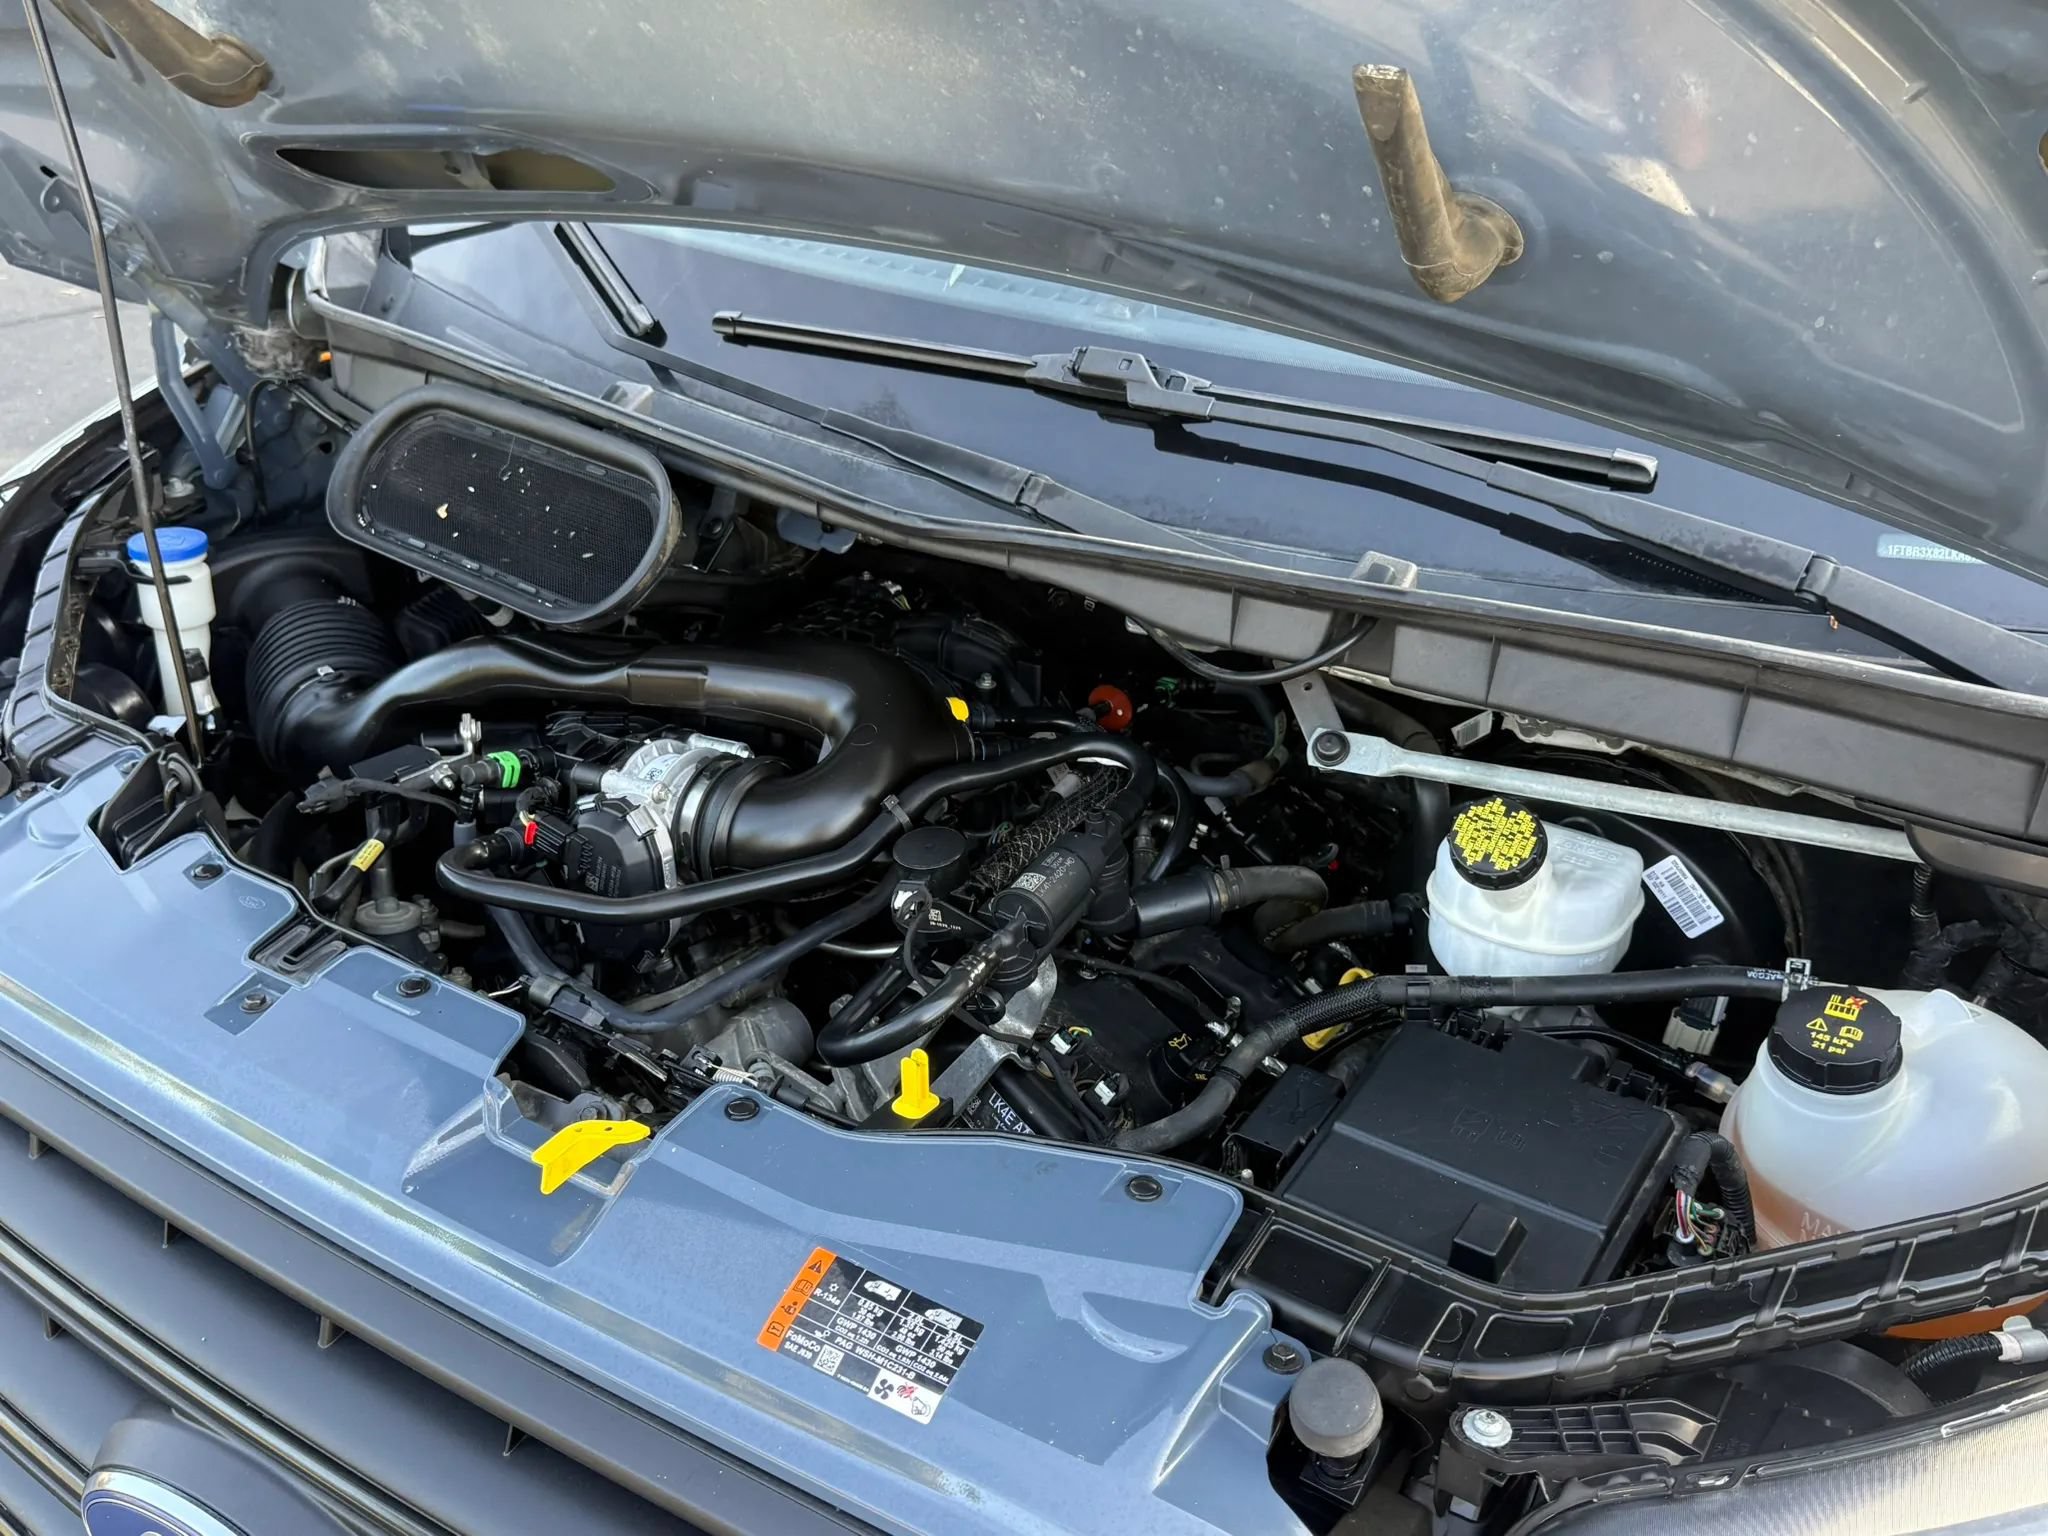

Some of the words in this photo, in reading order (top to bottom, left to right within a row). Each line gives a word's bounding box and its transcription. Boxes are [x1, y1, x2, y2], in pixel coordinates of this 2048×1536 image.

[1810, 1031, 1831, 1042] 145
[1832, 1037, 1854, 1048] kPa
[1811, 1041, 1826, 1050] 21
[1828, 1046, 1846, 1055] psi
[988, 1092, 1016, 1126] LK4E
[813, 1287, 840, 1306] R-134a
[872, 1305, 884, 1317] kg
[836, 1316, 857, 1331] GWP
[856, 1326, 876, 1340] 1430
[912, 1325, 925, 1337] kg
[785, 1330, 822, 1354] FoMoCo
[834, 1336, 853, 1350] PAG
[952, 1344, 965, 1356] kg
[894, 1344, 916, 1359] GWP
[915, 1353, 936, 1368] 1430
